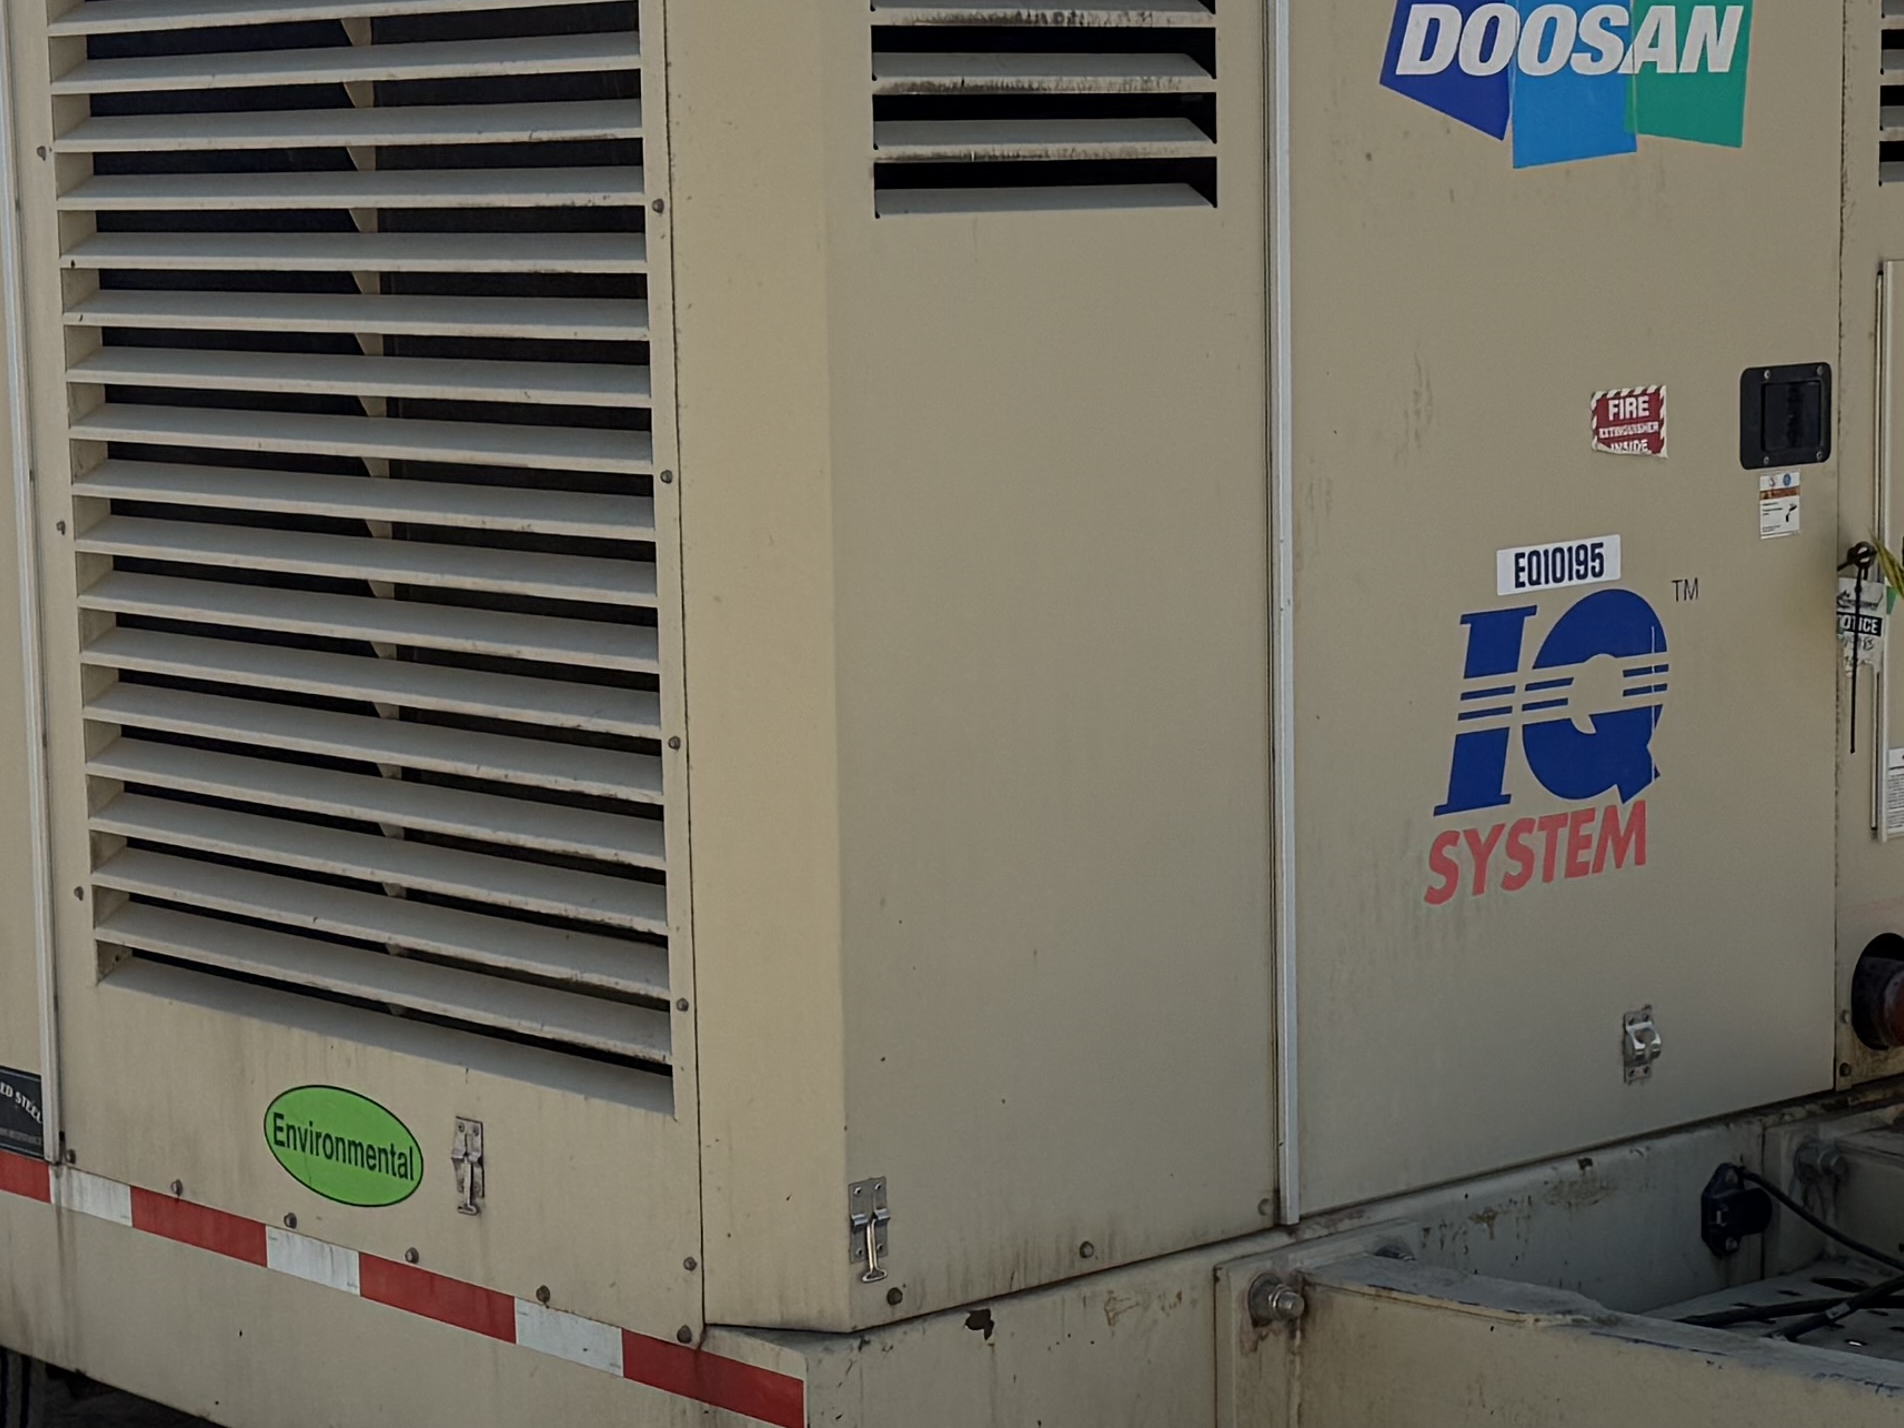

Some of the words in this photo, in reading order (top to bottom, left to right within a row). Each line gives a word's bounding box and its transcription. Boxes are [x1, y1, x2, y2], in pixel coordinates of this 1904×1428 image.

[1395, 3, 1744, 76] DOOSAN
[1598, 421, 1659, 439] EXTINGUISHER
[1608, 396, 1650, 421] FIRE
[1610, 439, 1649, 452] INSIDE
[1514, 542, 1605, 589] EQ10195
[1836, 614, 1879, 634] OICE
[1433, 588, 1670, 817] IQ
[1671, 577, 1699, 603] TM
[1423, 799, 1646, 905] SYSTEM
[273, 1112, 414, 1181] Environmental
